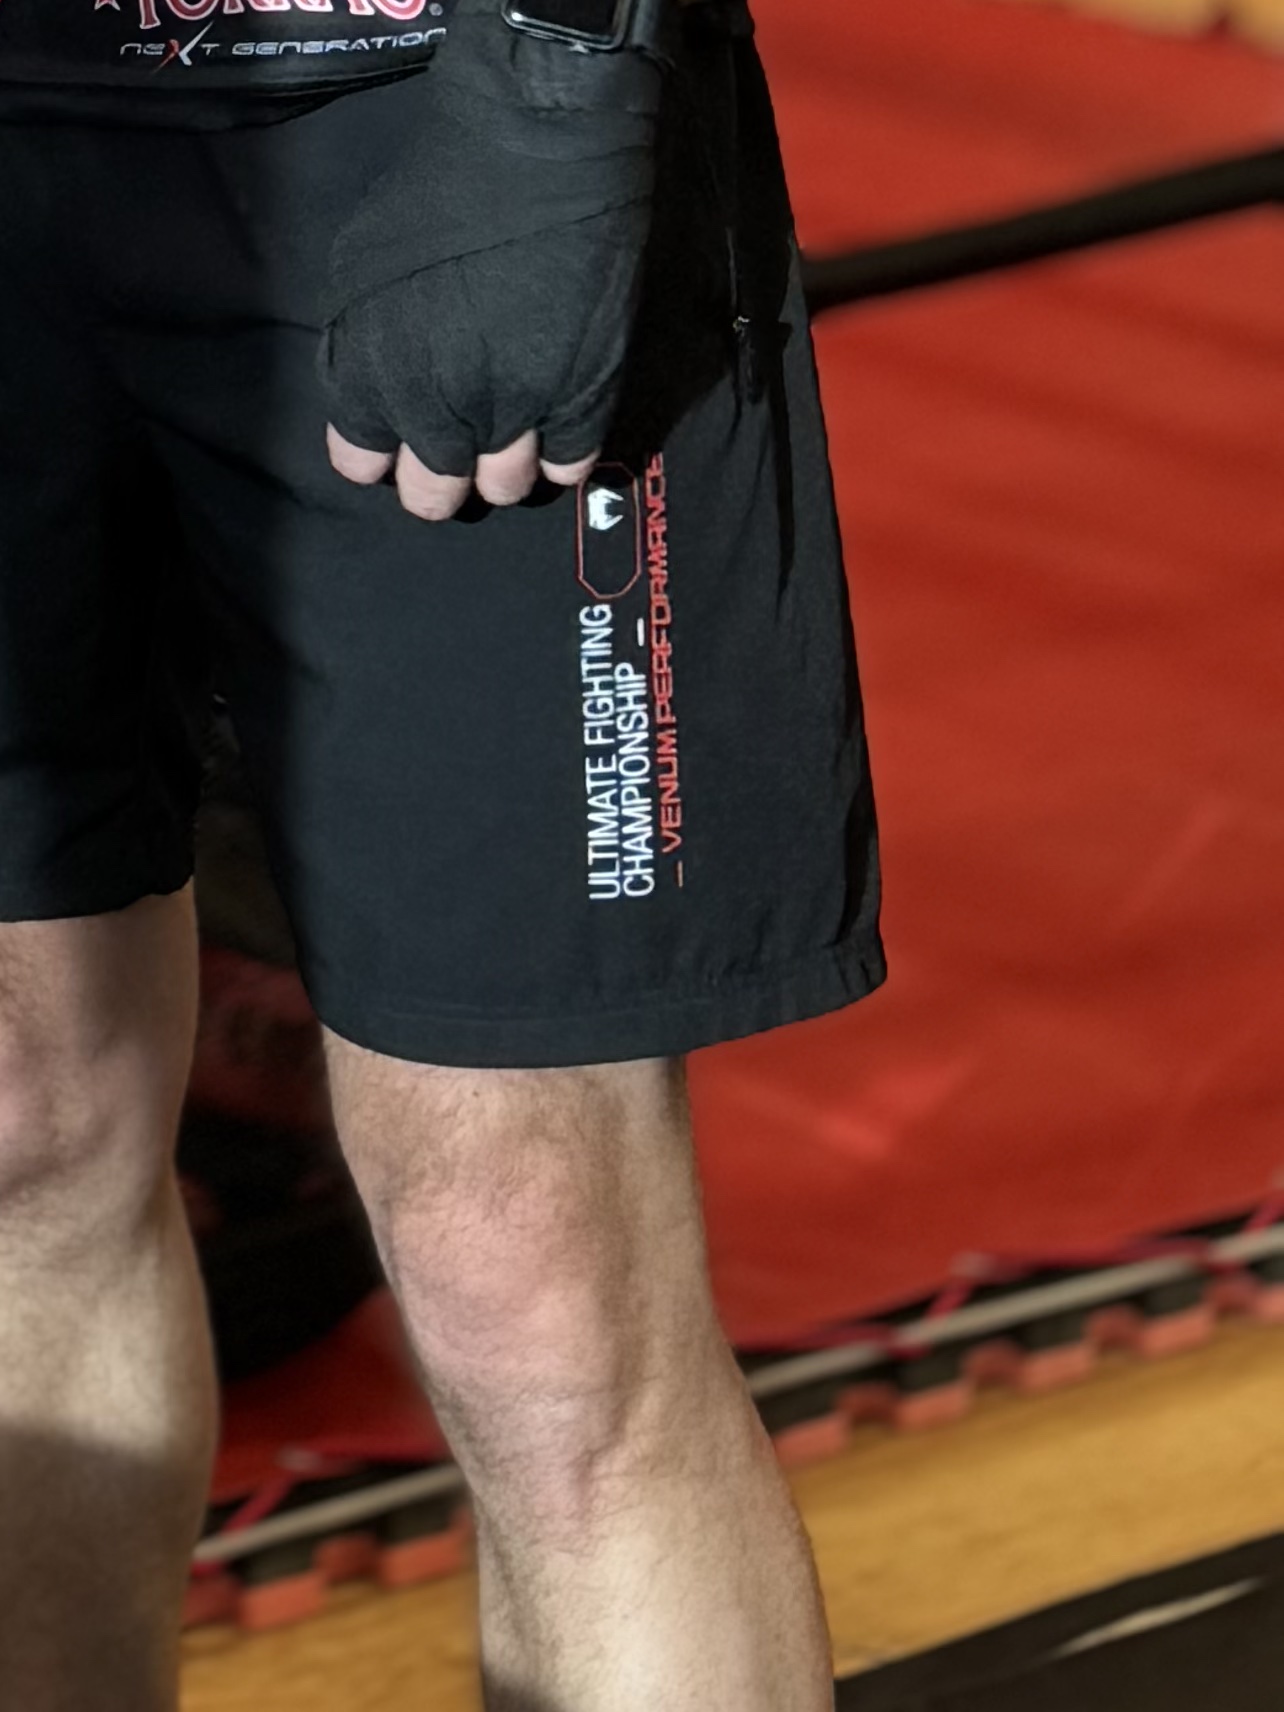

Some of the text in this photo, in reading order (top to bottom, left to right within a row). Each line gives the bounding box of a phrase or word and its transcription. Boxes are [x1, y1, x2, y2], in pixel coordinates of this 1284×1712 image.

[578, 603, 620, 900] ULTIMATE FIGHTING
[614, 661, 656, 898] CHAMPIONSHIP
[645, 451, 684, 853] VENUM PERFORMANCE
